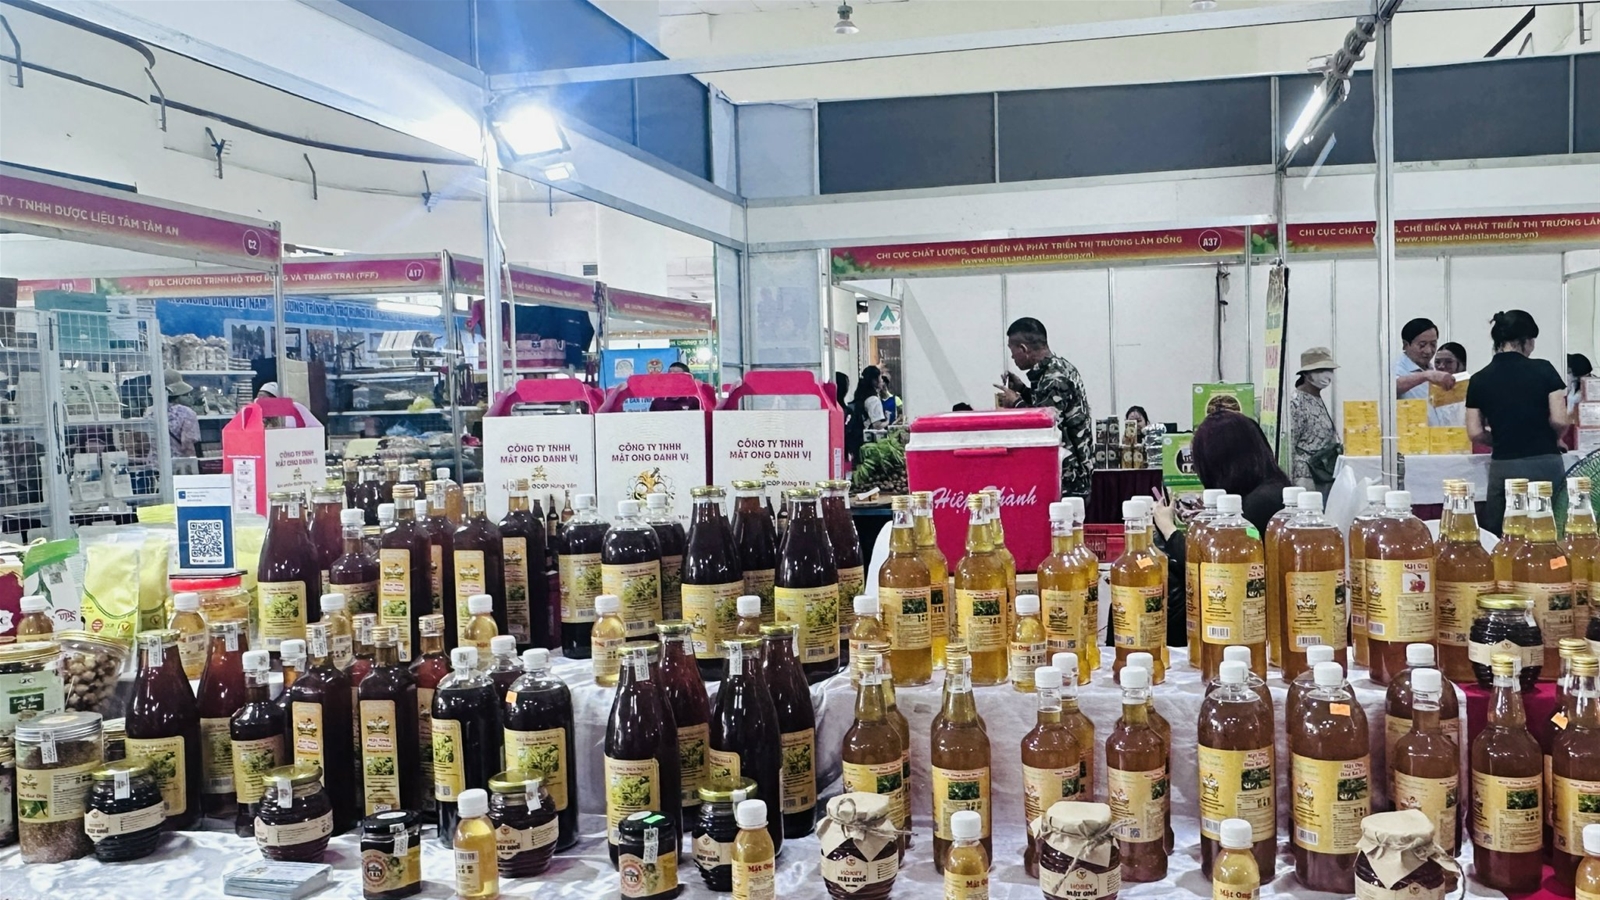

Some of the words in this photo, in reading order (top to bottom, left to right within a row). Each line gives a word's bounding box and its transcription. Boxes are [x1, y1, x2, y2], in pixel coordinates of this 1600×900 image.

[16, 198, 52, 214] TNHH
[54, 205, 88, 221] DƯỢC
[91, 211, 114, 226] LIỆU
[165, 226, 178, 236] AN
[1317, 228, 1336, 236] CỤC
[1404, 222, 1422, 233] CHẾ
[1424, 222, 1446, 232] BIẾN
[1449, 222, 1461, 230] VÀ
[1464, 221, 1488, 230] PHÁT
[1491, 218, 1520, 230] TRIỂN
[1540, 218, 1582, 228] TRƯỜNG
[971, 244, 988, 254] CHẾ
[1013, 242, 1024, 252] VÀ
[1026, 241, 1048, 250] PHÁT
[1052, 238, 1076, 249] TRIỂN
[1095, 238, 1132, 247] TRƯỜNG
[1135, 237, 1154, 245] LÂM
[1156, 234, 1183, 244] ĐỒNG
[1202, 238, 1218, 247] A37
[167, 276, 202, 286] CHƯƠNG
[290, 272, 301, 281] VÀ
[304, 272, 332, 280] TRANG
[249, 298, 267, 310] NAM
[508, 443, 534, 452] CÔNG
[548, 444, 570, 452] TNHH
[618, 442, 644, 452] CÔNG
[737, 438, 764, 448] CÔNG
[780, 440, 804, 448] TNHH
[500, 454, 518, 465] MẬT
[570, 454, 578, 464] VỊ
[612, 453, 629, 464] MẬT
[631, 454, 651, 462] ONG
[654, 453, 678, 461] DANH
[680, 453, 689, 463] VỊ
[730, 450, 748, 461] MẬT
[750, 450, 771, 459] ONG
[774, 450, 800, 458] DANH
[802, 450, 811, 461] VỊ
[748, 865, 762, 873] Mật
[966, 880, 980, 888] Mật
[1220, 889, 1233, 899] Mật
